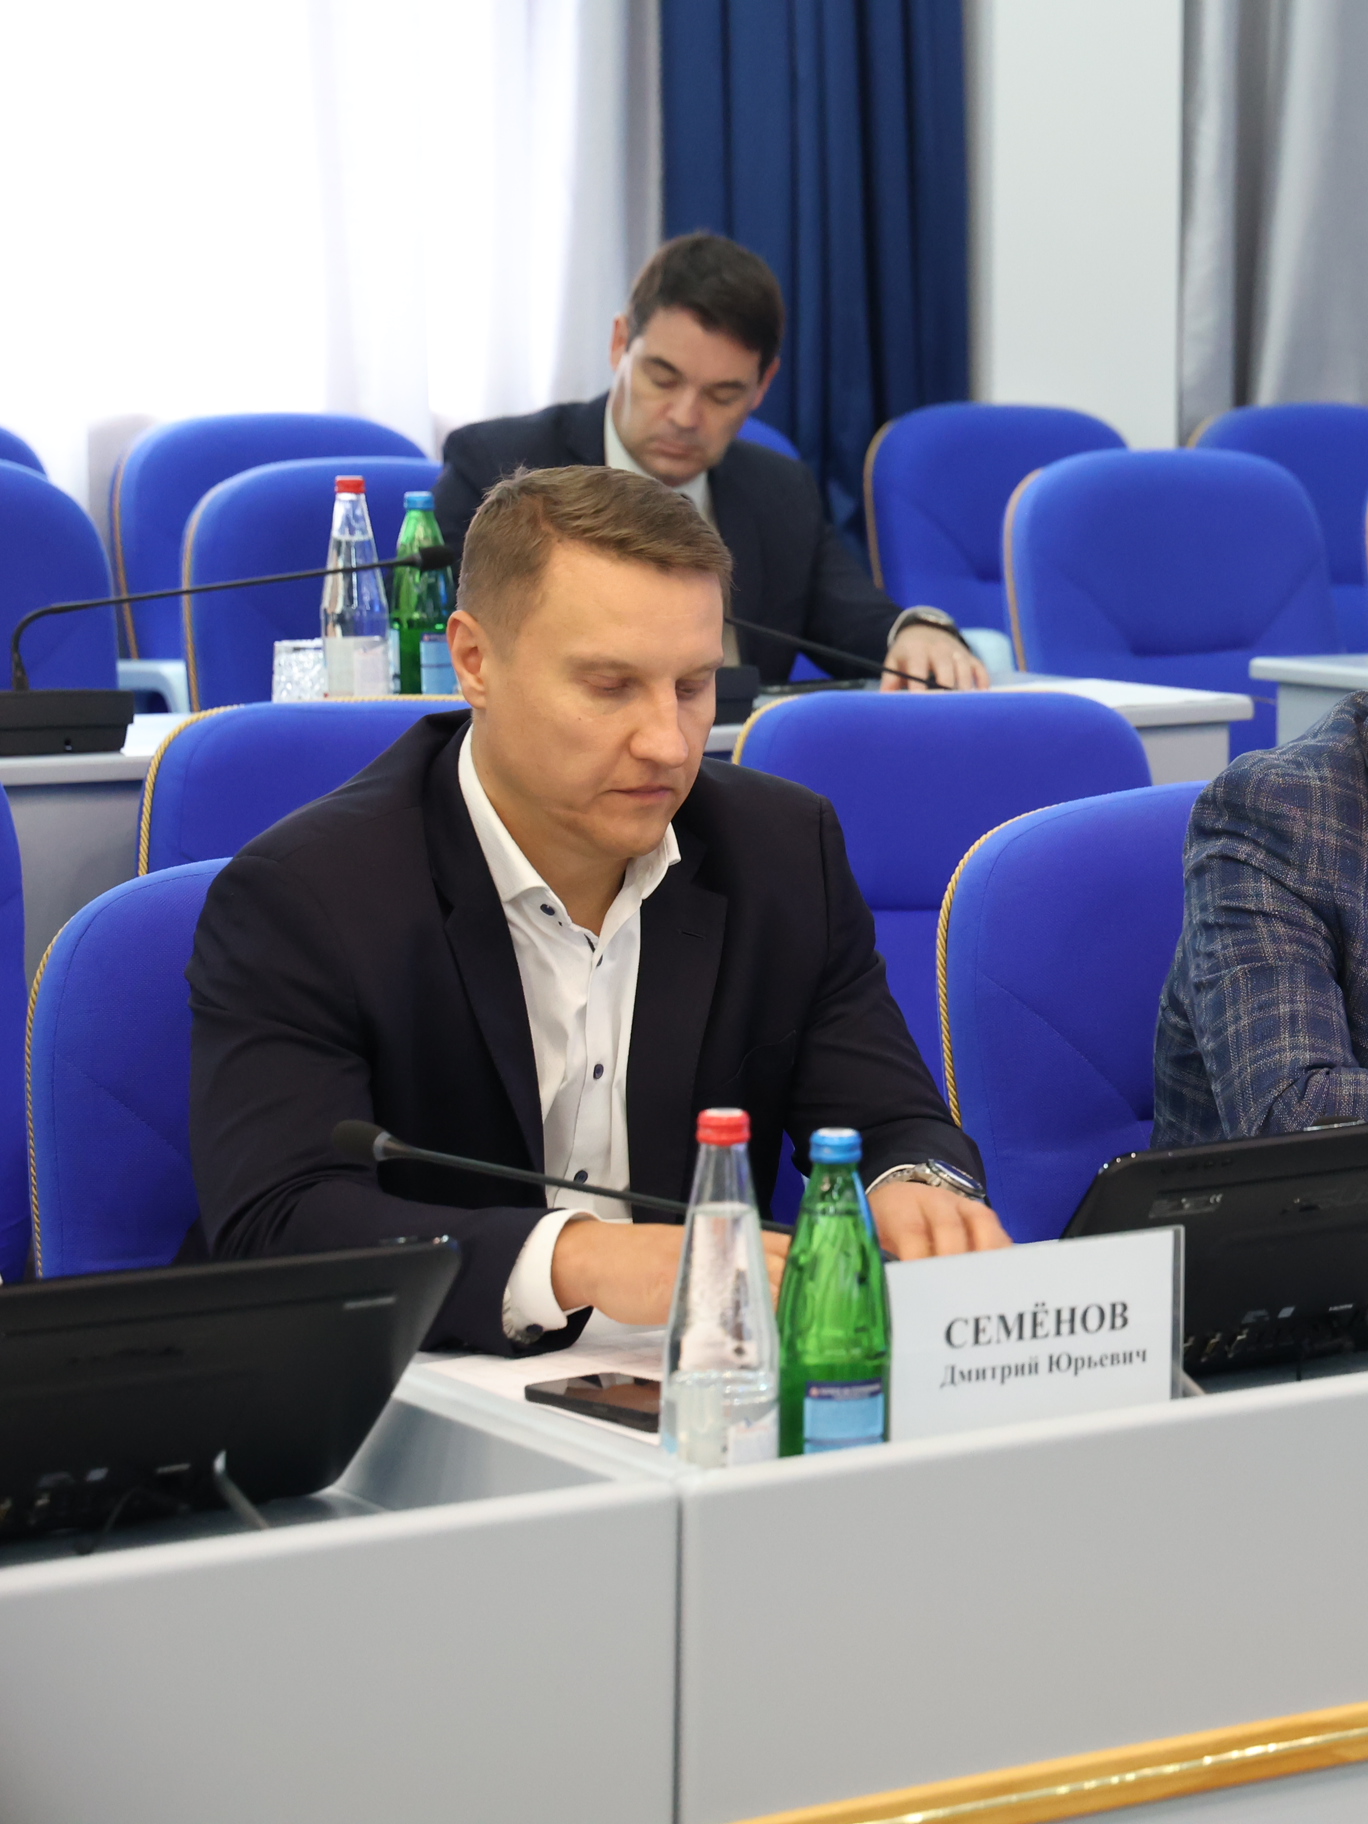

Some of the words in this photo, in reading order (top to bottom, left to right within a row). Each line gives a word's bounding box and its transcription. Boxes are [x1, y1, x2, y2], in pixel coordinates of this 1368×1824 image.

[944, 1301, 1129, 1349] СЕМЁНОВ
[940, 1356, 1039, 1388] Дмитрий
[1048, 1349, 1147, 1377] Юрьевич
